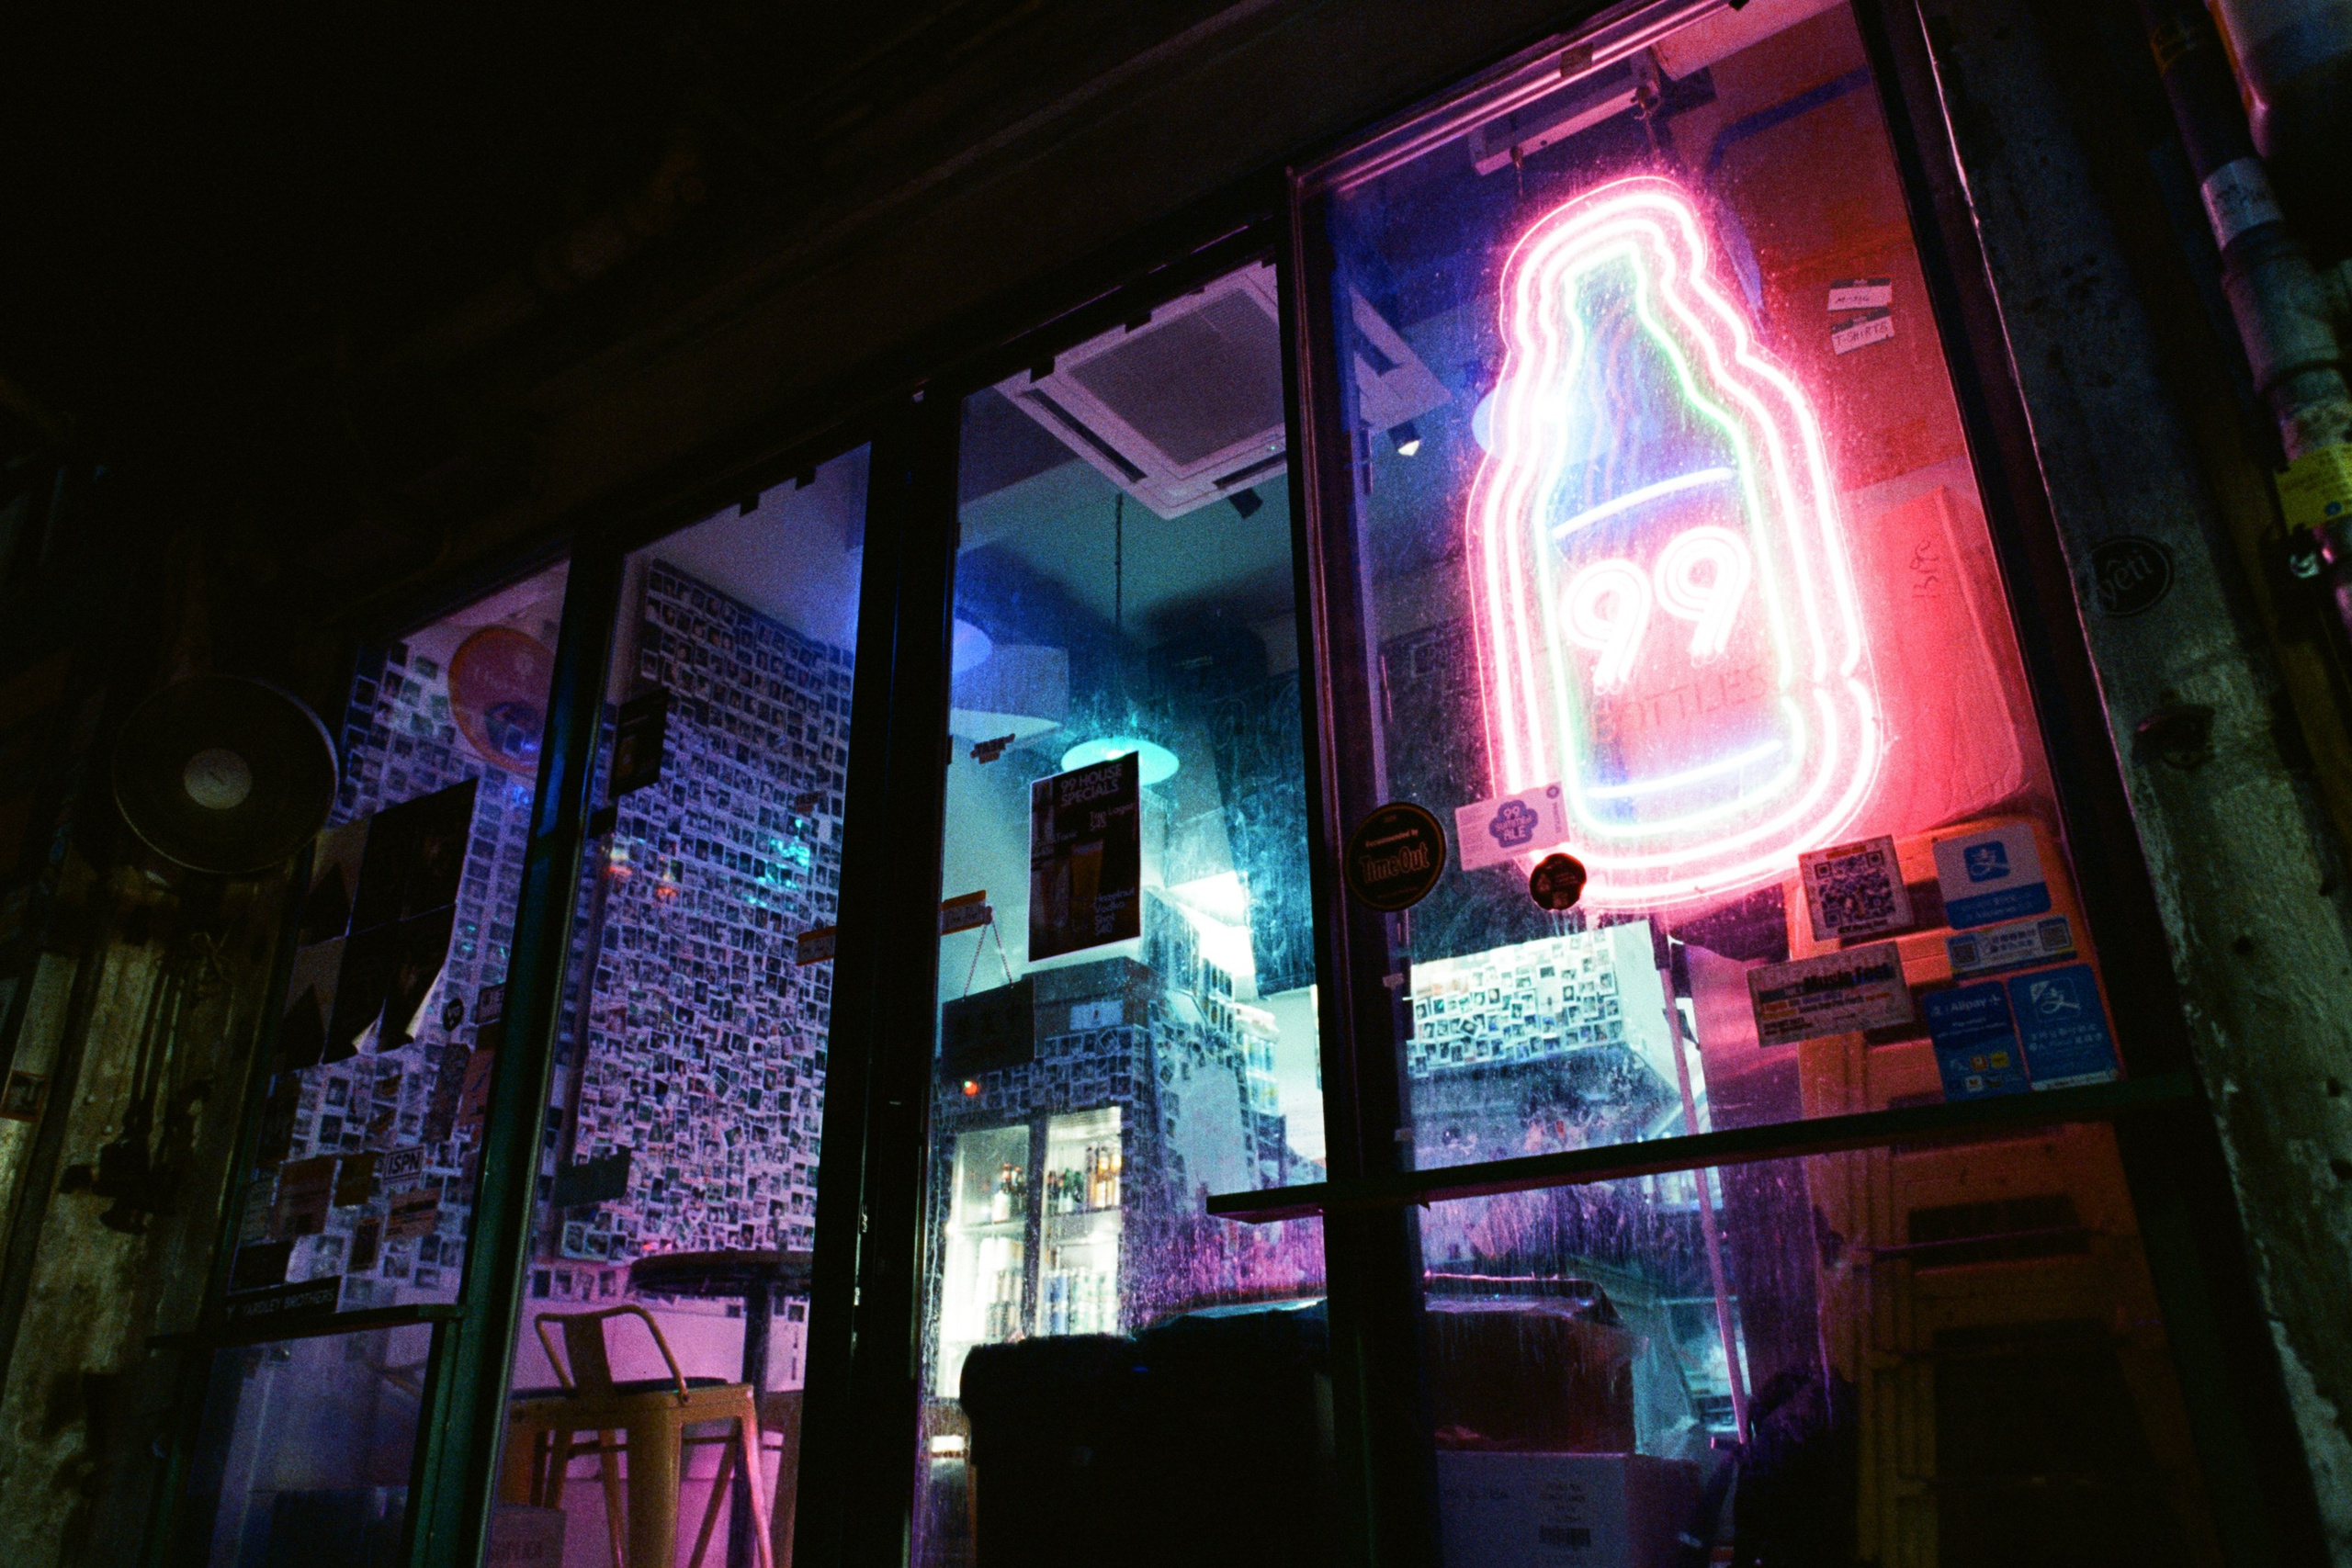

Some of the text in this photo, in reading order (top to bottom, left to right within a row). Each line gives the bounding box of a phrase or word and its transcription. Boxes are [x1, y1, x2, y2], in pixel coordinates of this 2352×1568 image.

[1561, 521, 1751, 695] 99
[1590, 663, 1769, 742] BOTTLES
[1060, 763, 1123, 794] 99 HOUSE
[1060, 778, 1120, 807] SPECIALS
[1504, 825, 1526, 840] ALE
[388, 1151, 423, 1176] ISPN
